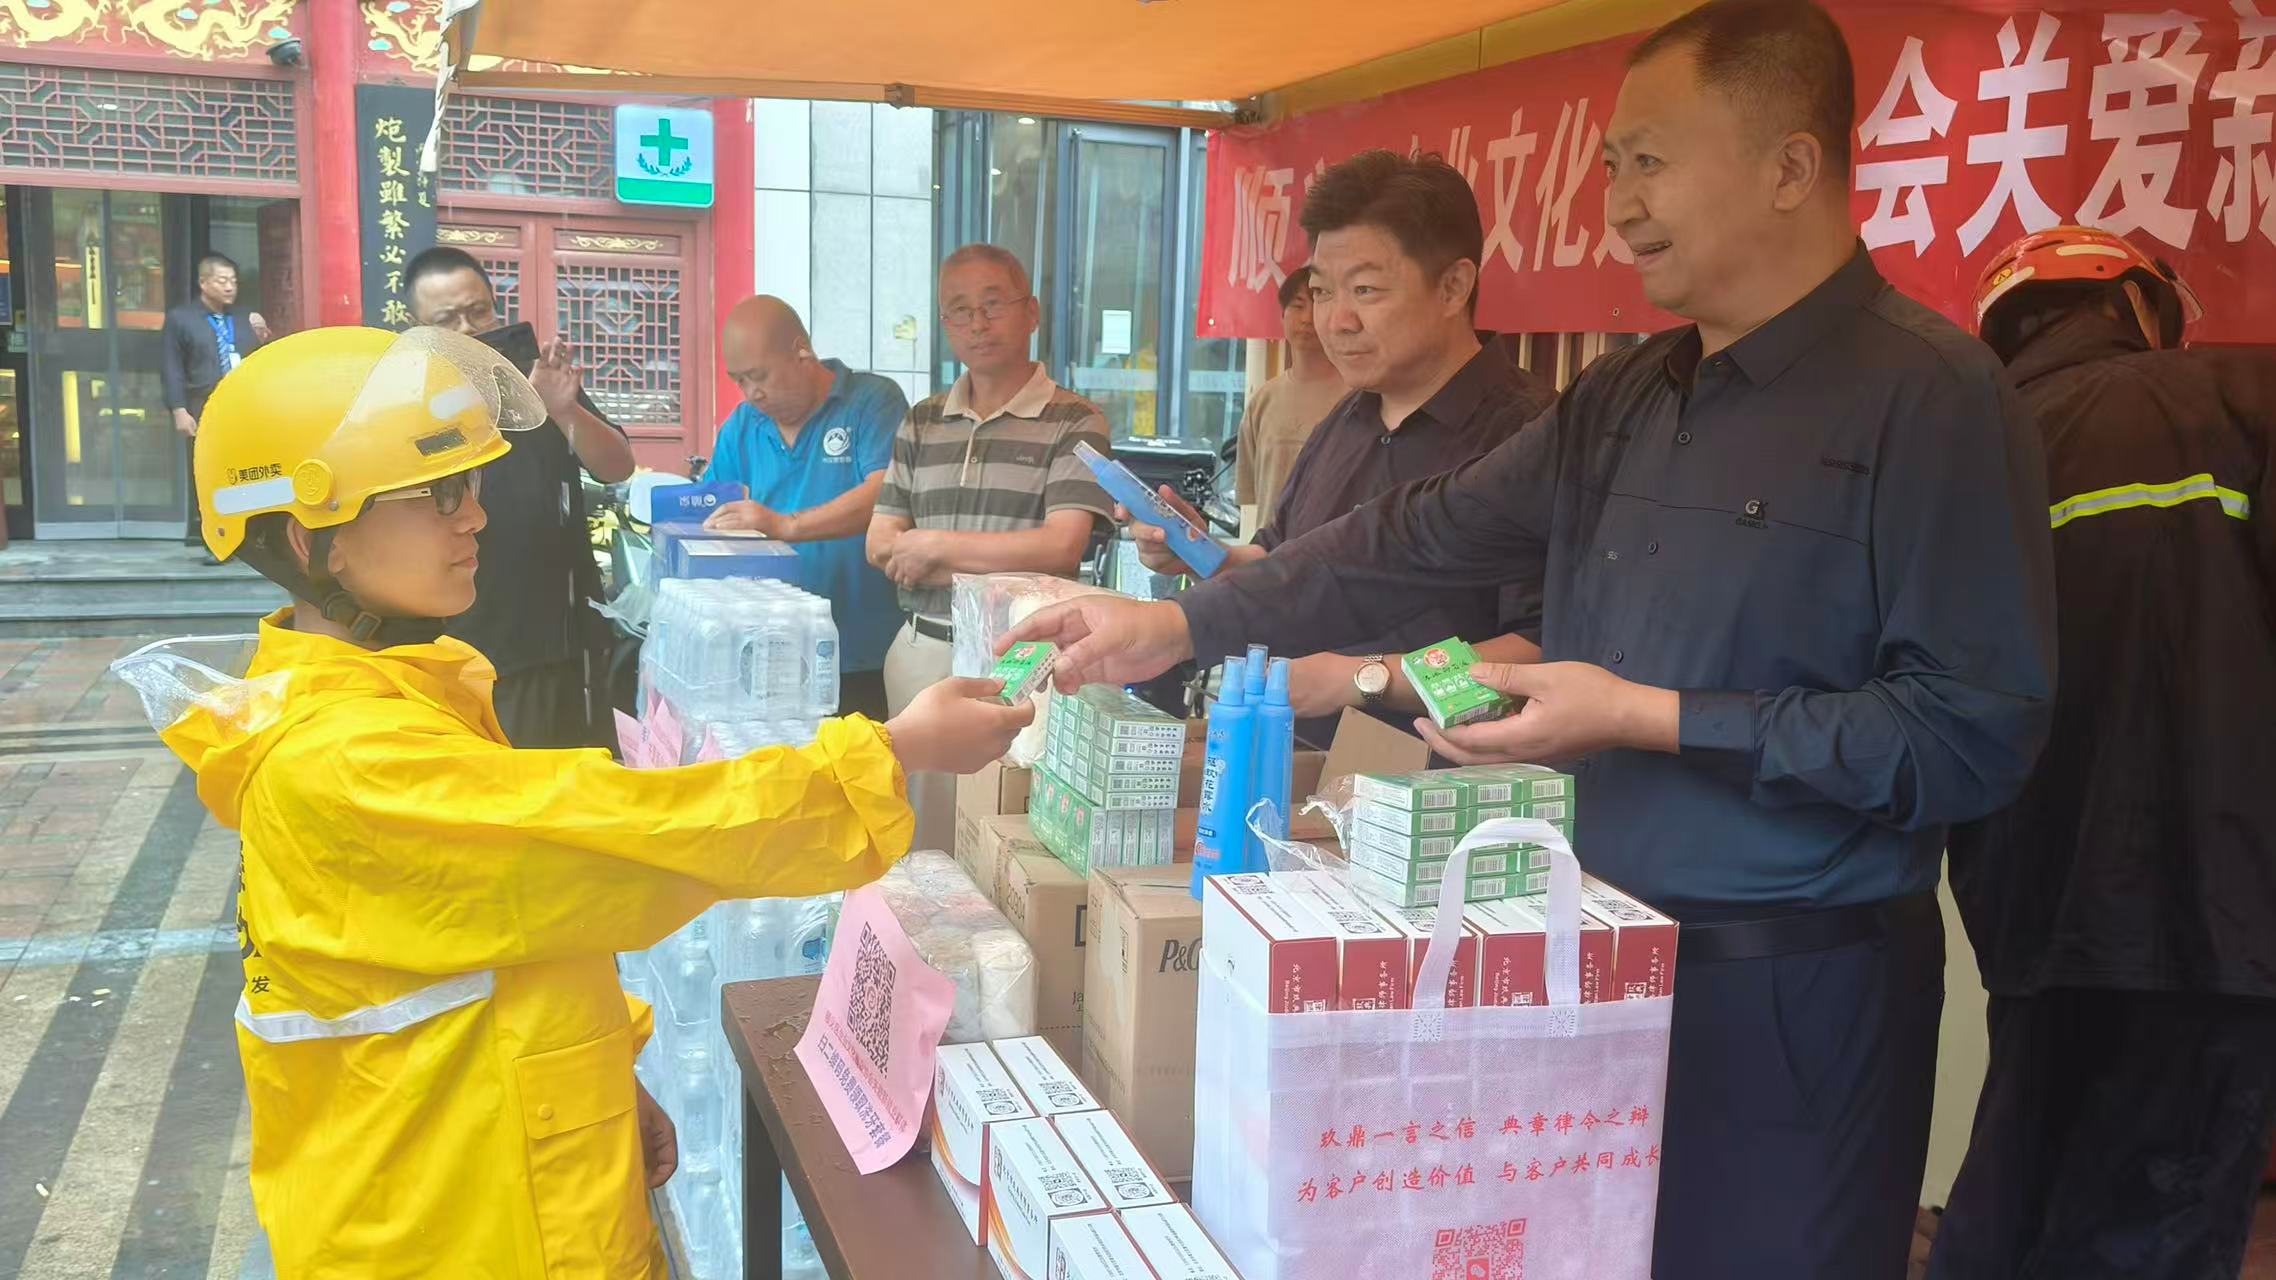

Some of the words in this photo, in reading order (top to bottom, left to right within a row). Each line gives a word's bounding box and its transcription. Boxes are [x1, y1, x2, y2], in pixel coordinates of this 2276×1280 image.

[238, 463, 282, 481] 美团外卖
[251, 975, 270, 994] 发
[1319, 1117, 1477, 1149] 玖鼎一言之信
[1498, 1105, 1650, 1138] 典章律令之辩
[1297, 1163, 1477, 1203] 为客户创造价值
[1497, 1144, 1661, 1184] 与客户共同成长
